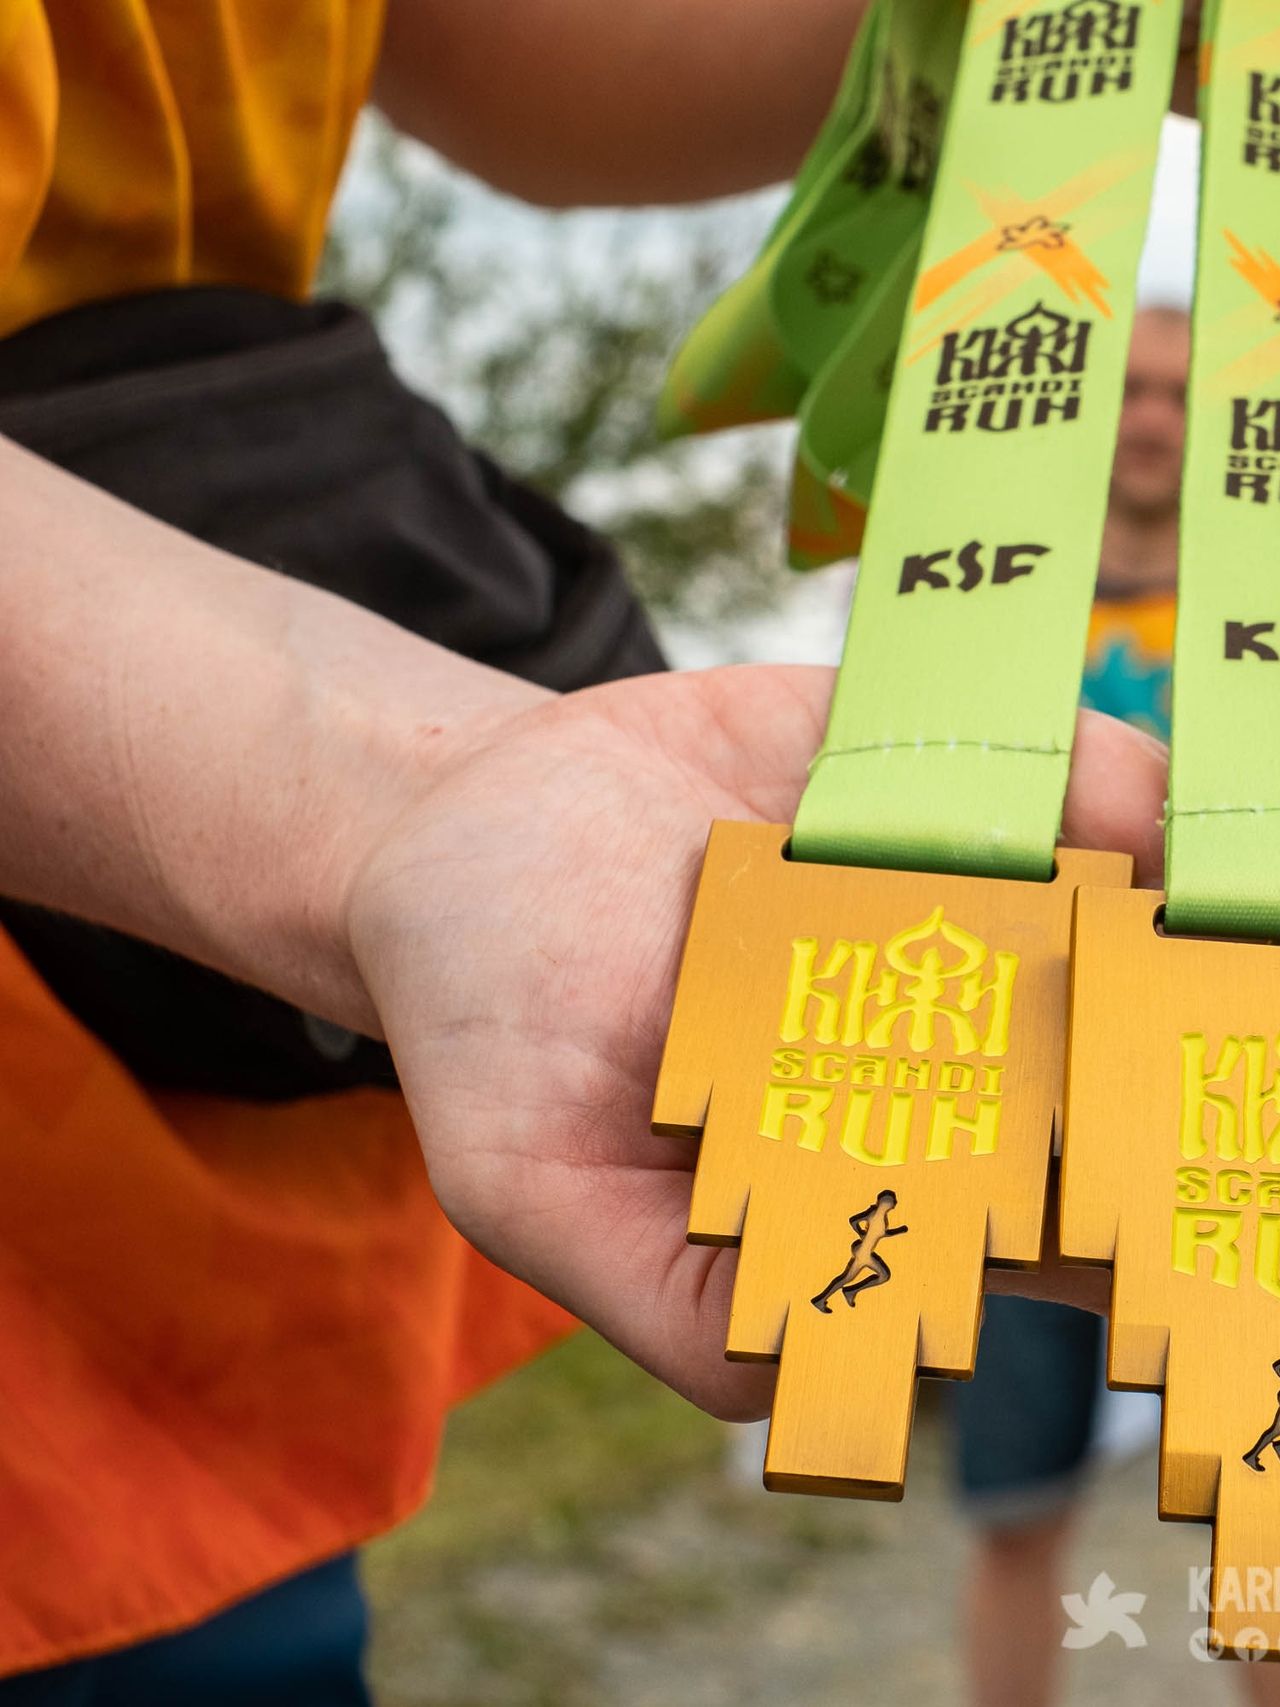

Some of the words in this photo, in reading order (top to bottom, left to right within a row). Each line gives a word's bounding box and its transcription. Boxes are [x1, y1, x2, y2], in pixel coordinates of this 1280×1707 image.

[990, 70, 1133, 103] RUN
[924, 396, 1081, 432] RUN
[897, 540, 1052, 596] KSF
[757, 1082, 1002, 1167] RUN
